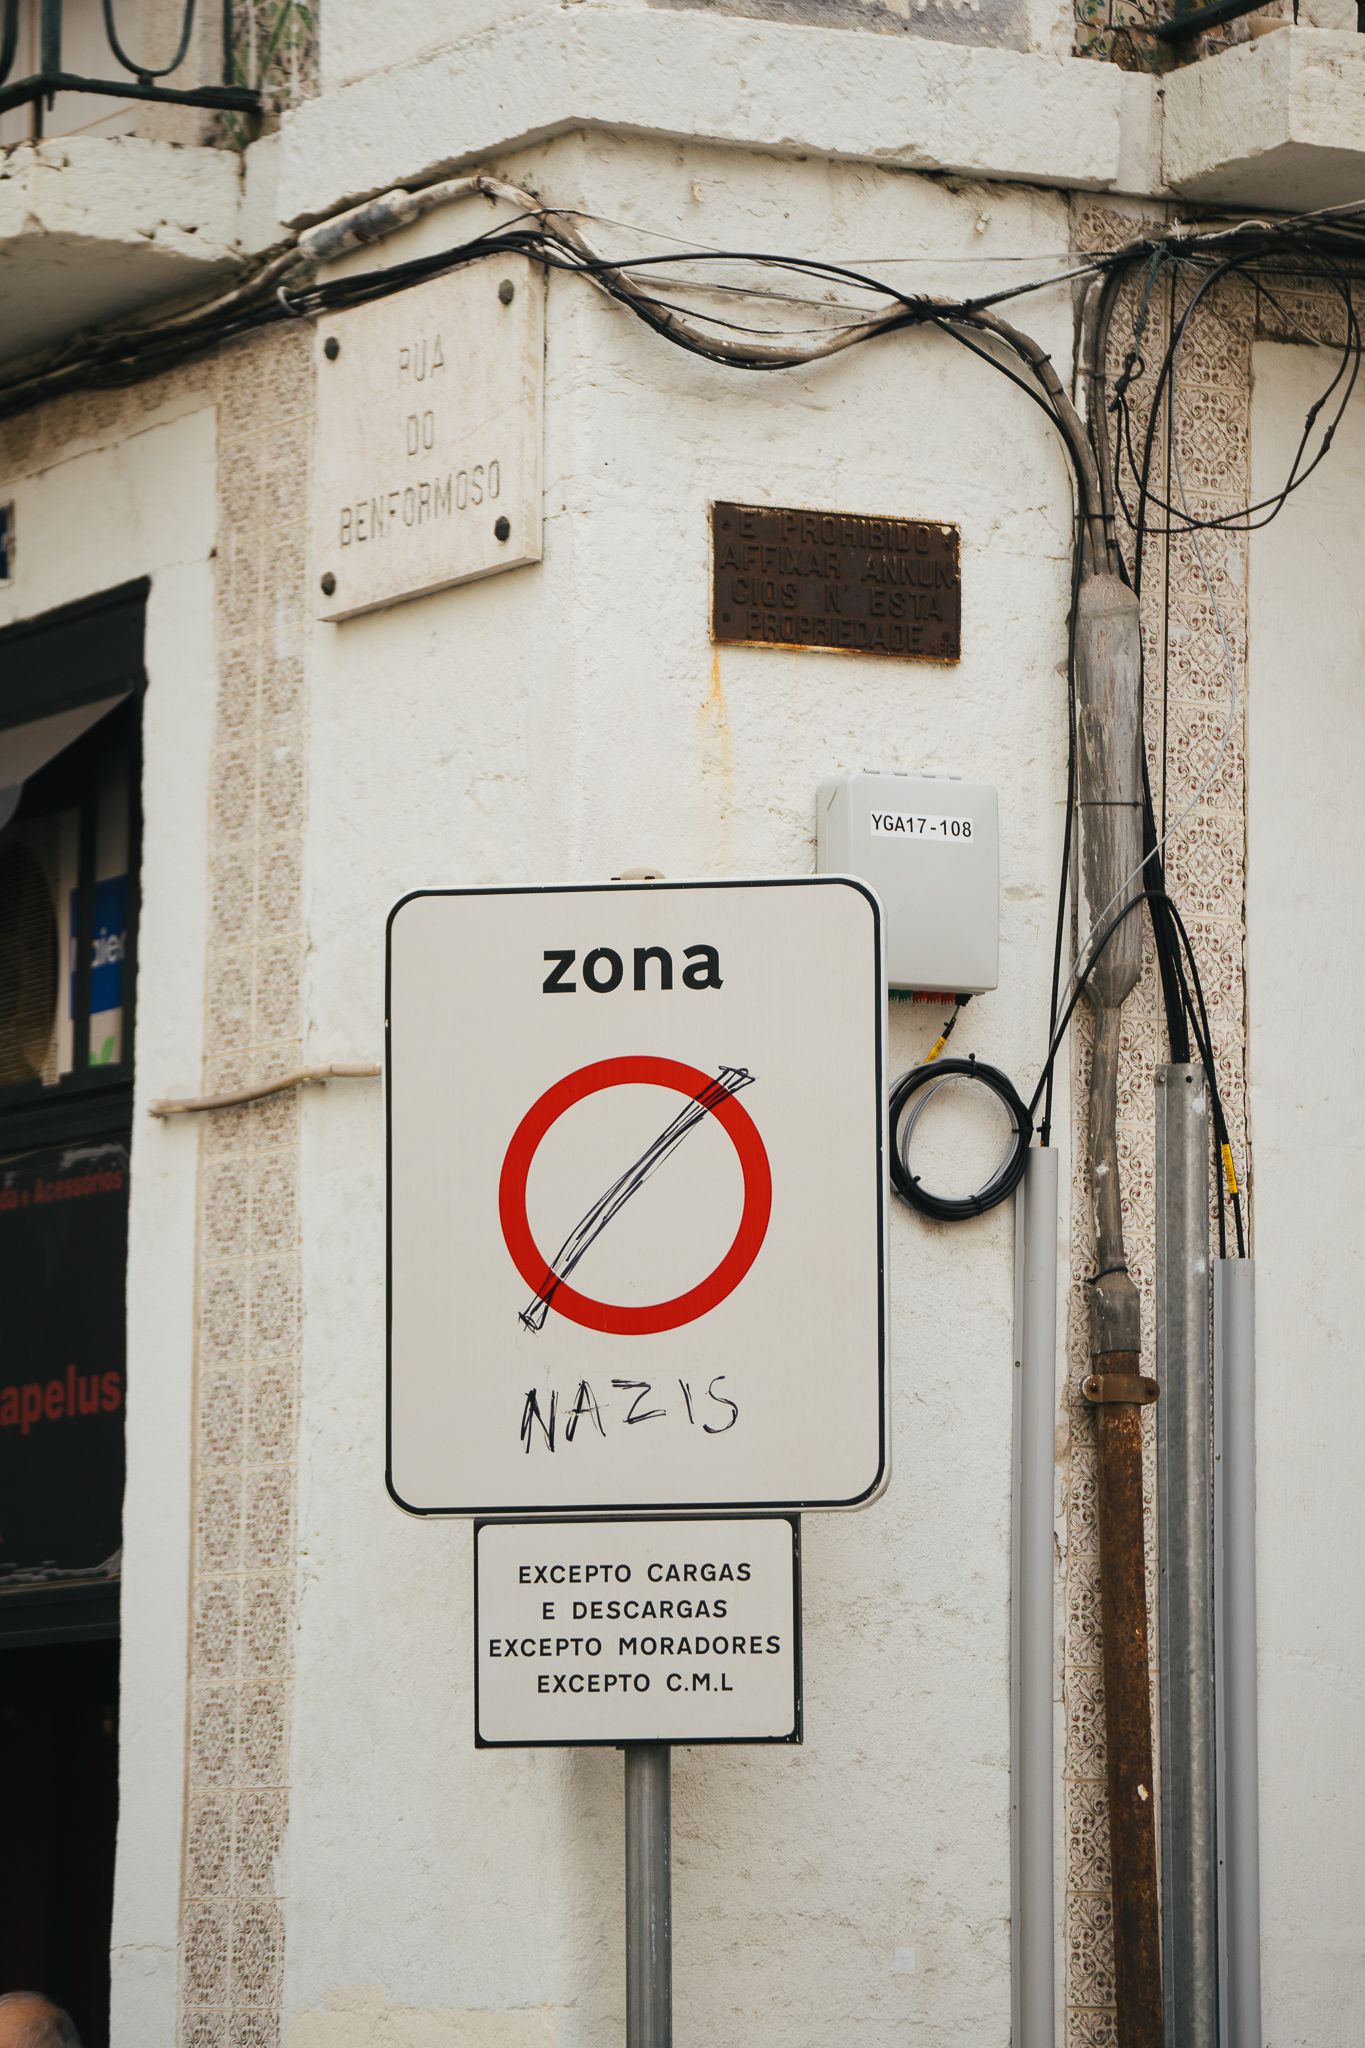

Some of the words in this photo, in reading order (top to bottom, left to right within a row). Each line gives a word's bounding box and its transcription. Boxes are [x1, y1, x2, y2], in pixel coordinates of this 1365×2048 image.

[399, 334, 445, 383] RUA
[406, 410, 435, 456] DO
[340, 459, 501, 547] BENFORMOSO
[781, 513, 931, 556] PROHIBIDO
[719, 542, 841, 580] AFFIXAR
[731, 575, 799, 610] CIOS
[869, 585, 944, 623] ESTA
[745, 610, 925, 652] PROPRIEDADE
[871, 813, 972, 838] YGA17-108
[542, 943, 724, 994] zona
[33, 1168, 123, 1204] Acessórios
[0, 1363, 121, 1435] apelus
[520, 1375, 739, 1454] NAZIS
[518, 1564, 633, 1585] EXCEPTO
[647, 1562, 752, 1583] CARGAS
[541, 1601, 556, 1621] E
[572, 1599, 728, 1620] DESCARGAS
[489, 1637, 603, 1658] EXCEPTO
[618, 1635, 781, 1656] MORADORES
[537, 1673, 651, 1694] EXCEPTO
[666, 1672, 734, 1692] C.M.L
